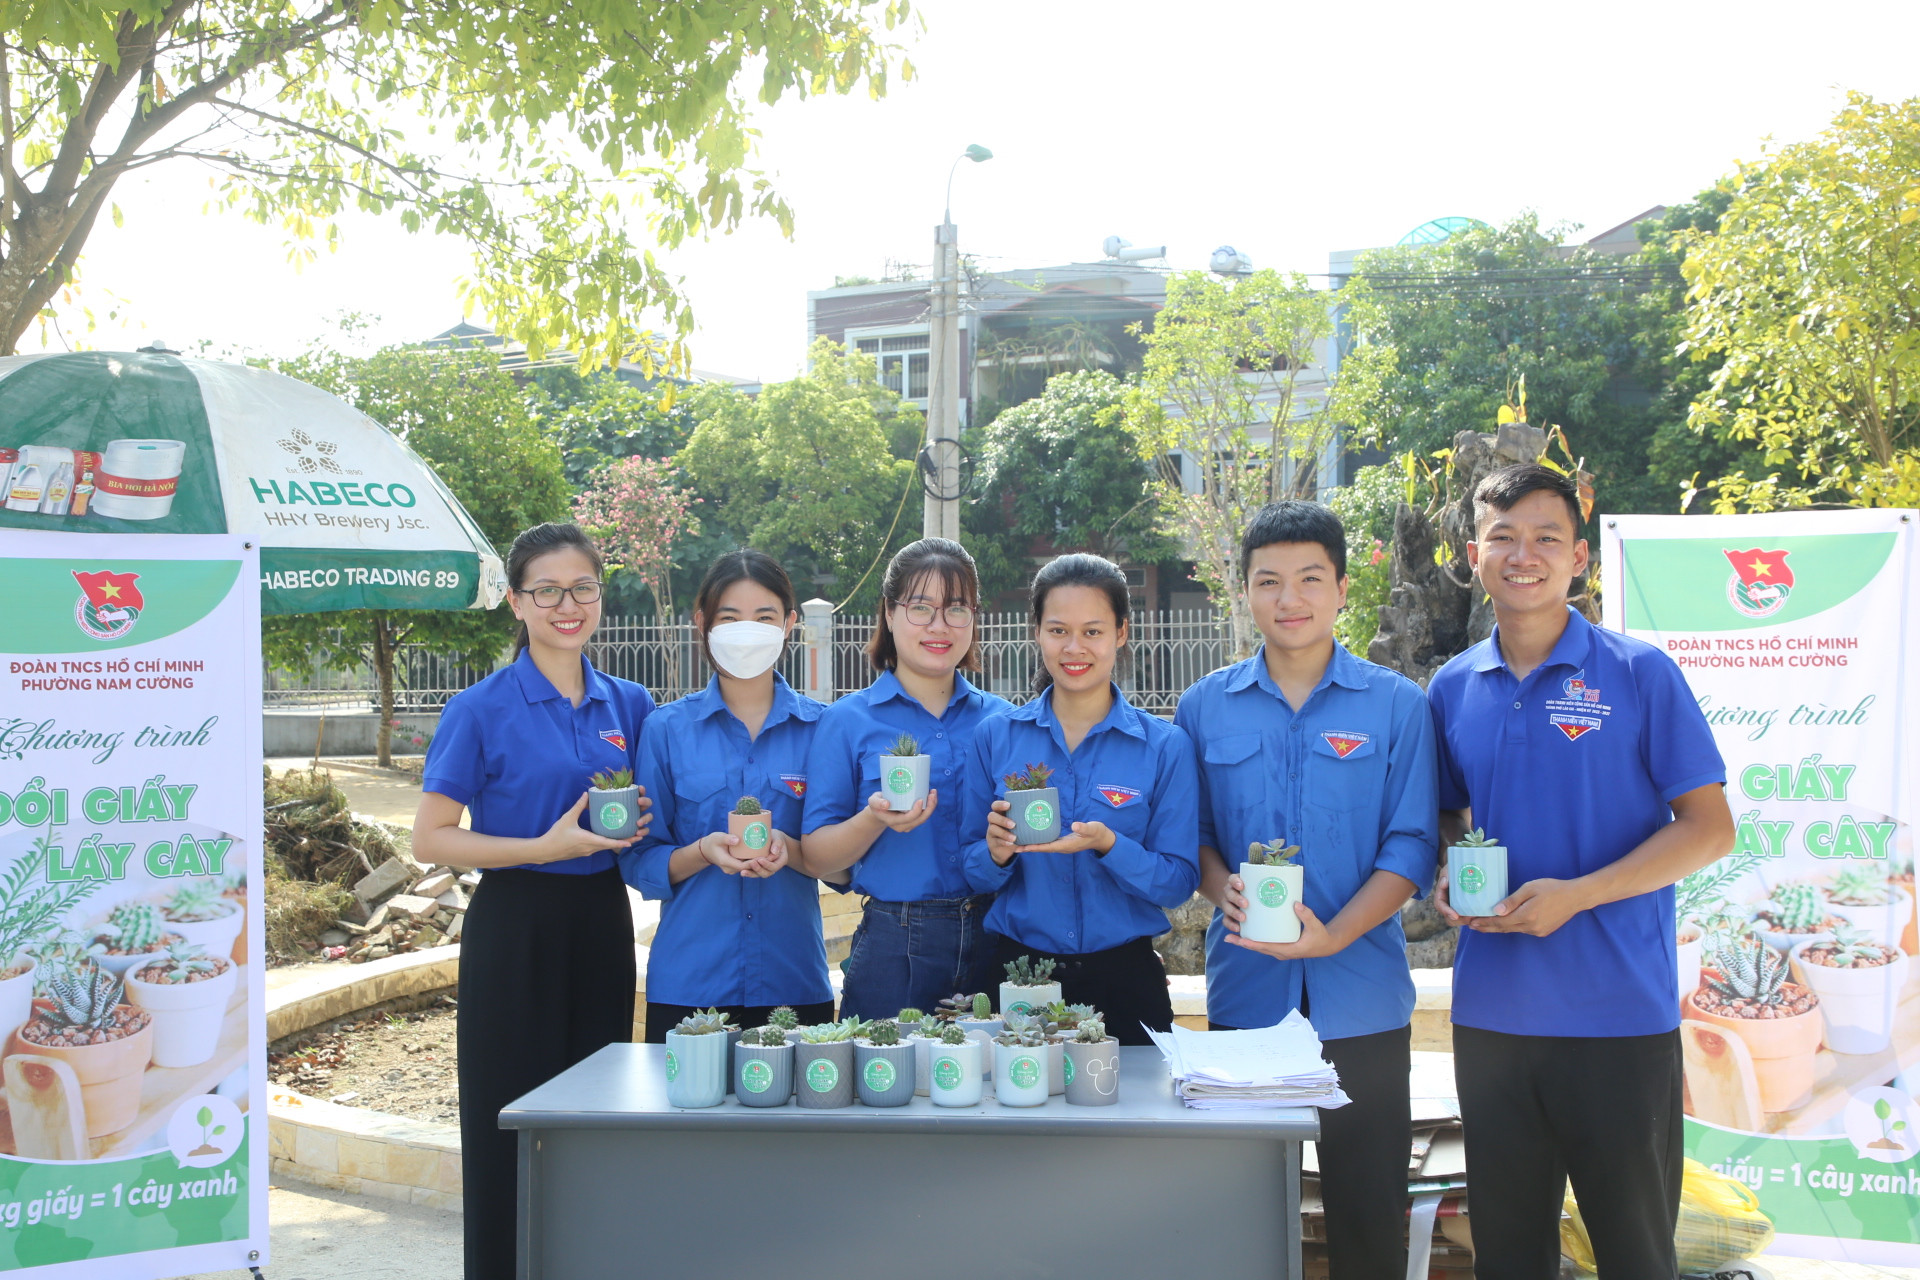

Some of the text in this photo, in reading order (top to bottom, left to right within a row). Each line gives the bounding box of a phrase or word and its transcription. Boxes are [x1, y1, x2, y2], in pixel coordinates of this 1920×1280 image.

[108, 480, 123, 488] BIA
[248, 477, 416, 508] HABECO
[264, 512, 430, 533] HHY Brewery Jsc.
[261, 567, 460, 590] HABECO TRADING 89
[1668, 635, 1858, 651] ĐOÀN TNCS HỒ CHÍ MINH
[10, 657, 204, 674] ĐOÀN TNCS HỒ CHÍ MINH
[1679, 653, 1848, 668] PHƯỜNG NAM CƯỜNG
[22, 676, 194, 691] PHƯỜNG NAM CƯỜNG
[1788, 694, 1876, 726] trình
[0, 715, 218, 765] Chương trình
[1740, 753, 1856, 801] GIẤY
[82, 775, 198, 824] GIẤY
[1728, 810, 1896, 859] ẤY CÂY
[46, 833, 233, 883] LẤY CÂY
[1790, 1162, 1803, 1187] 1
[1808, 1164, 1854, 1197] cây
[1859, 1168, 1920, 1195] xanh
[27, 1185, 84, 1225] giấy
[112, 1183, 122, 1207] 1
[128, 1179, 173, 1209] cây
[178, 1170, 237, 1200] xanh
